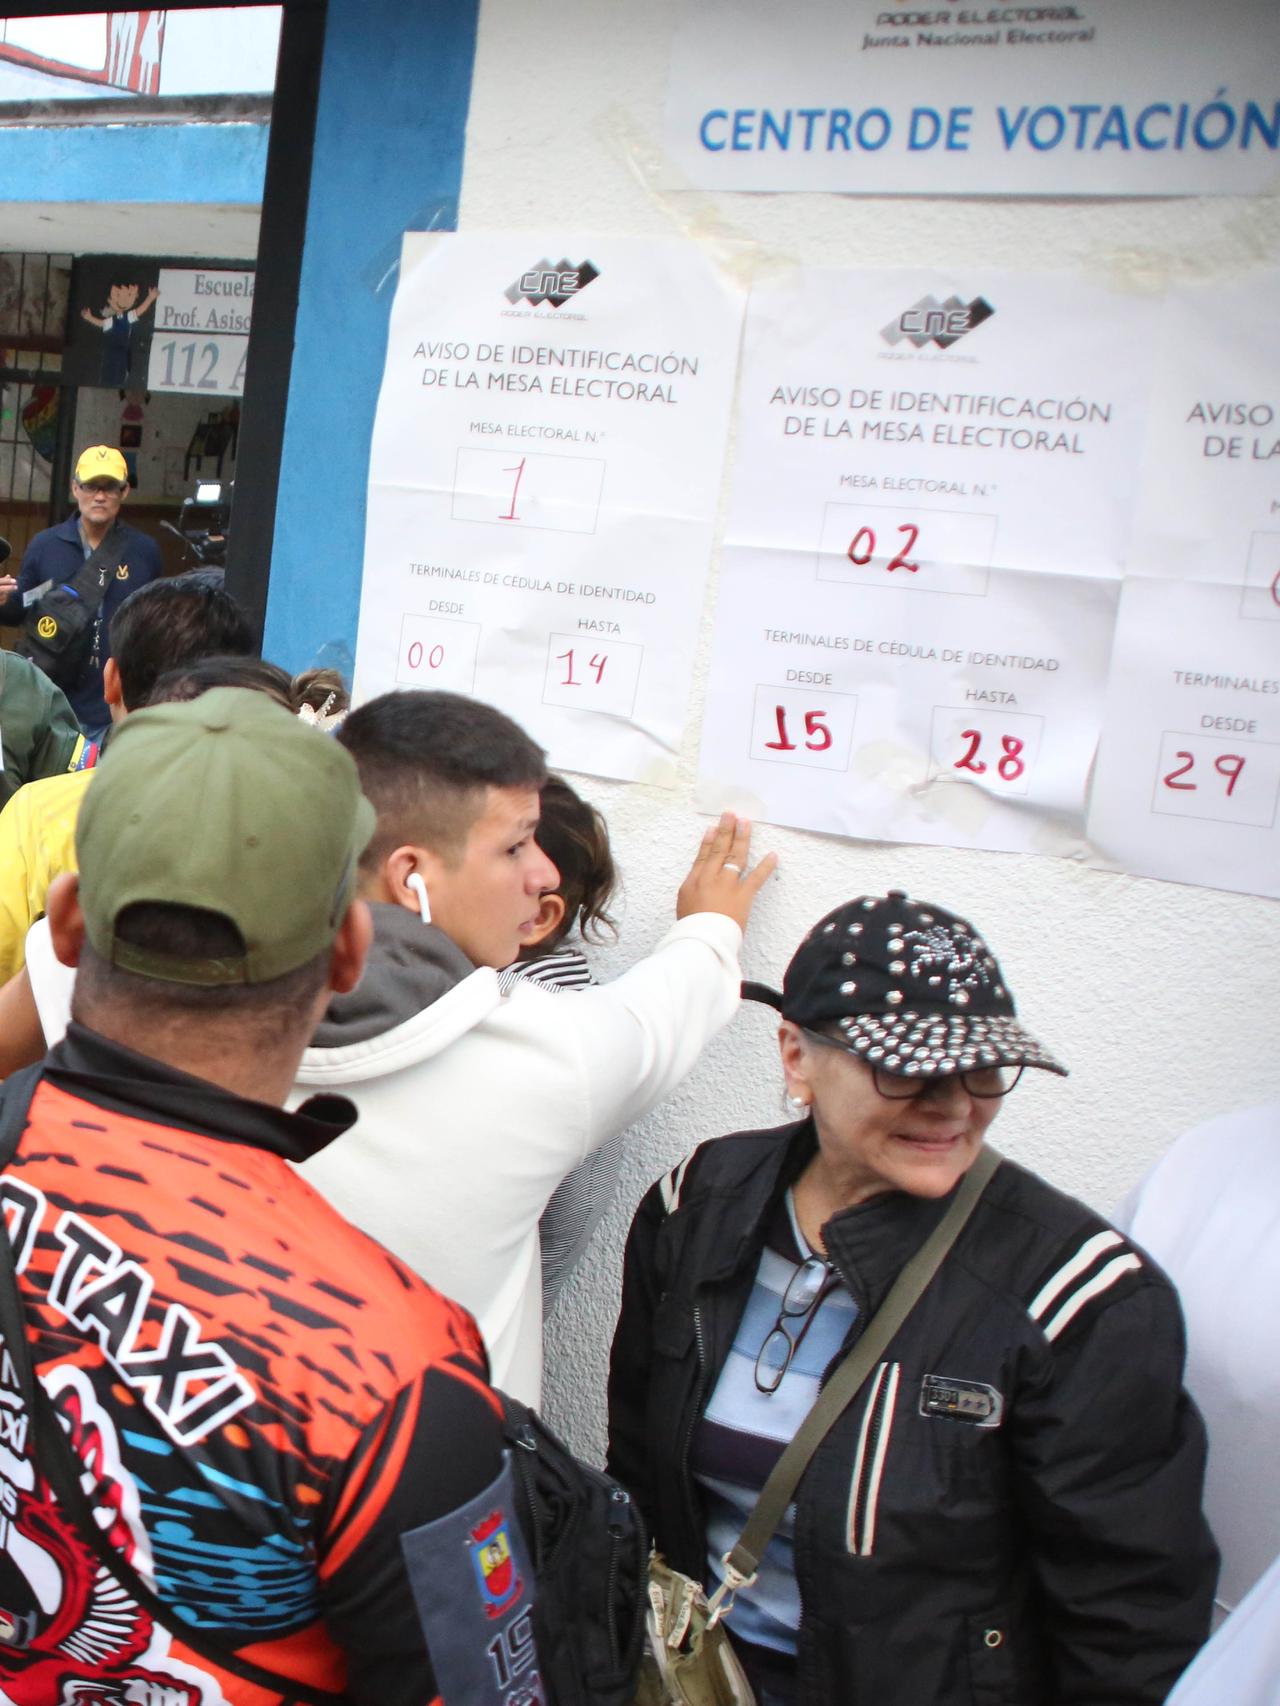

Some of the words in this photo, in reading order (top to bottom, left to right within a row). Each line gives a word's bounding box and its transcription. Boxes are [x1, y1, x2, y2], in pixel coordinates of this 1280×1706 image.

[876, 11, 950, 26] PODER
[957, 6, 1085, 24] ELECTORAL
[862, 32, 910, 50] Junta
[917, 30, 1000, 47] Nacional
[1006, 27, 1096, 44] Electoral
[699, 107, 892, 152] CENTRO
[907, 107, 974, 152] DE
[995, 87, 1280, 152] VOTACIÓN
[162, 305, 200, 328] Prof.
[159, 340, 220, 389] 112
[412, 341, 470, 361] AVISO
[476, 343, 505, 363] DE
[511, 345, 699, 376] IDENTIFICACIÓN
[421, 367, 448, 388] DE
[454, 370, 480, 390] LA
[487, 371, 543, 394] MESA
[550, 376, 679, 404] ELECTORAL
[768, 384, 842, 409] AVISO
[849, 388, 883, 411] DE
[890, 390, 1112, 424] IDENTIFICACIÓN
[1186, 403, 1275, 427] AVISO
[469, 421, 503, 435] MESA
[507, 424, 581, 442] ELECTORAL
[783, 415, 816, 437] DE
[823, 417, 853, 439] LA
[860, 420, 925, 444] MESA
[932, 422, 1086, 455] ELECTORAL
[1203, 435, 1242, 459] DE
[1252, 438, 1280, 461] LA
[497, 457, 526, 520] 1
[839, 473, 877, 489] MESA
[882, 476, 969, 495] ELECTORAL
[846, 522, 920, 573] 02
[409, 562, 480, 583] TERMINALES
[483, 571, 499, 586] DE
[556, 581, 576, 596] DE
[578, 583, 656, 605] IDENTIDAD
[428, 599, 465, 615] DESDE
[577, 618, 621, 635] HASTA
[407, 641, 445, 669] 00
[556, 648, 609, 686] 14
[763, 628, 850, 651] TERMINALES
[853, 637, 874, 653] DE
[941, 648, 964, 664] DE
[967, 650, 1061, 672] IDENTIDAD
[785, 668, 833, 686] DESDE
[1173, 670, 1280, 694] TERMINALES
[964, 688, 1018, 706] HASTA
[763, 704, 834, 752] 15
[1200, 713, 1258, 735] DESDE
[953, 727, 1026, 782] 28
[1163, 750, 1246, 797] 29
[47, 1212, 256, 1447] TAXI
